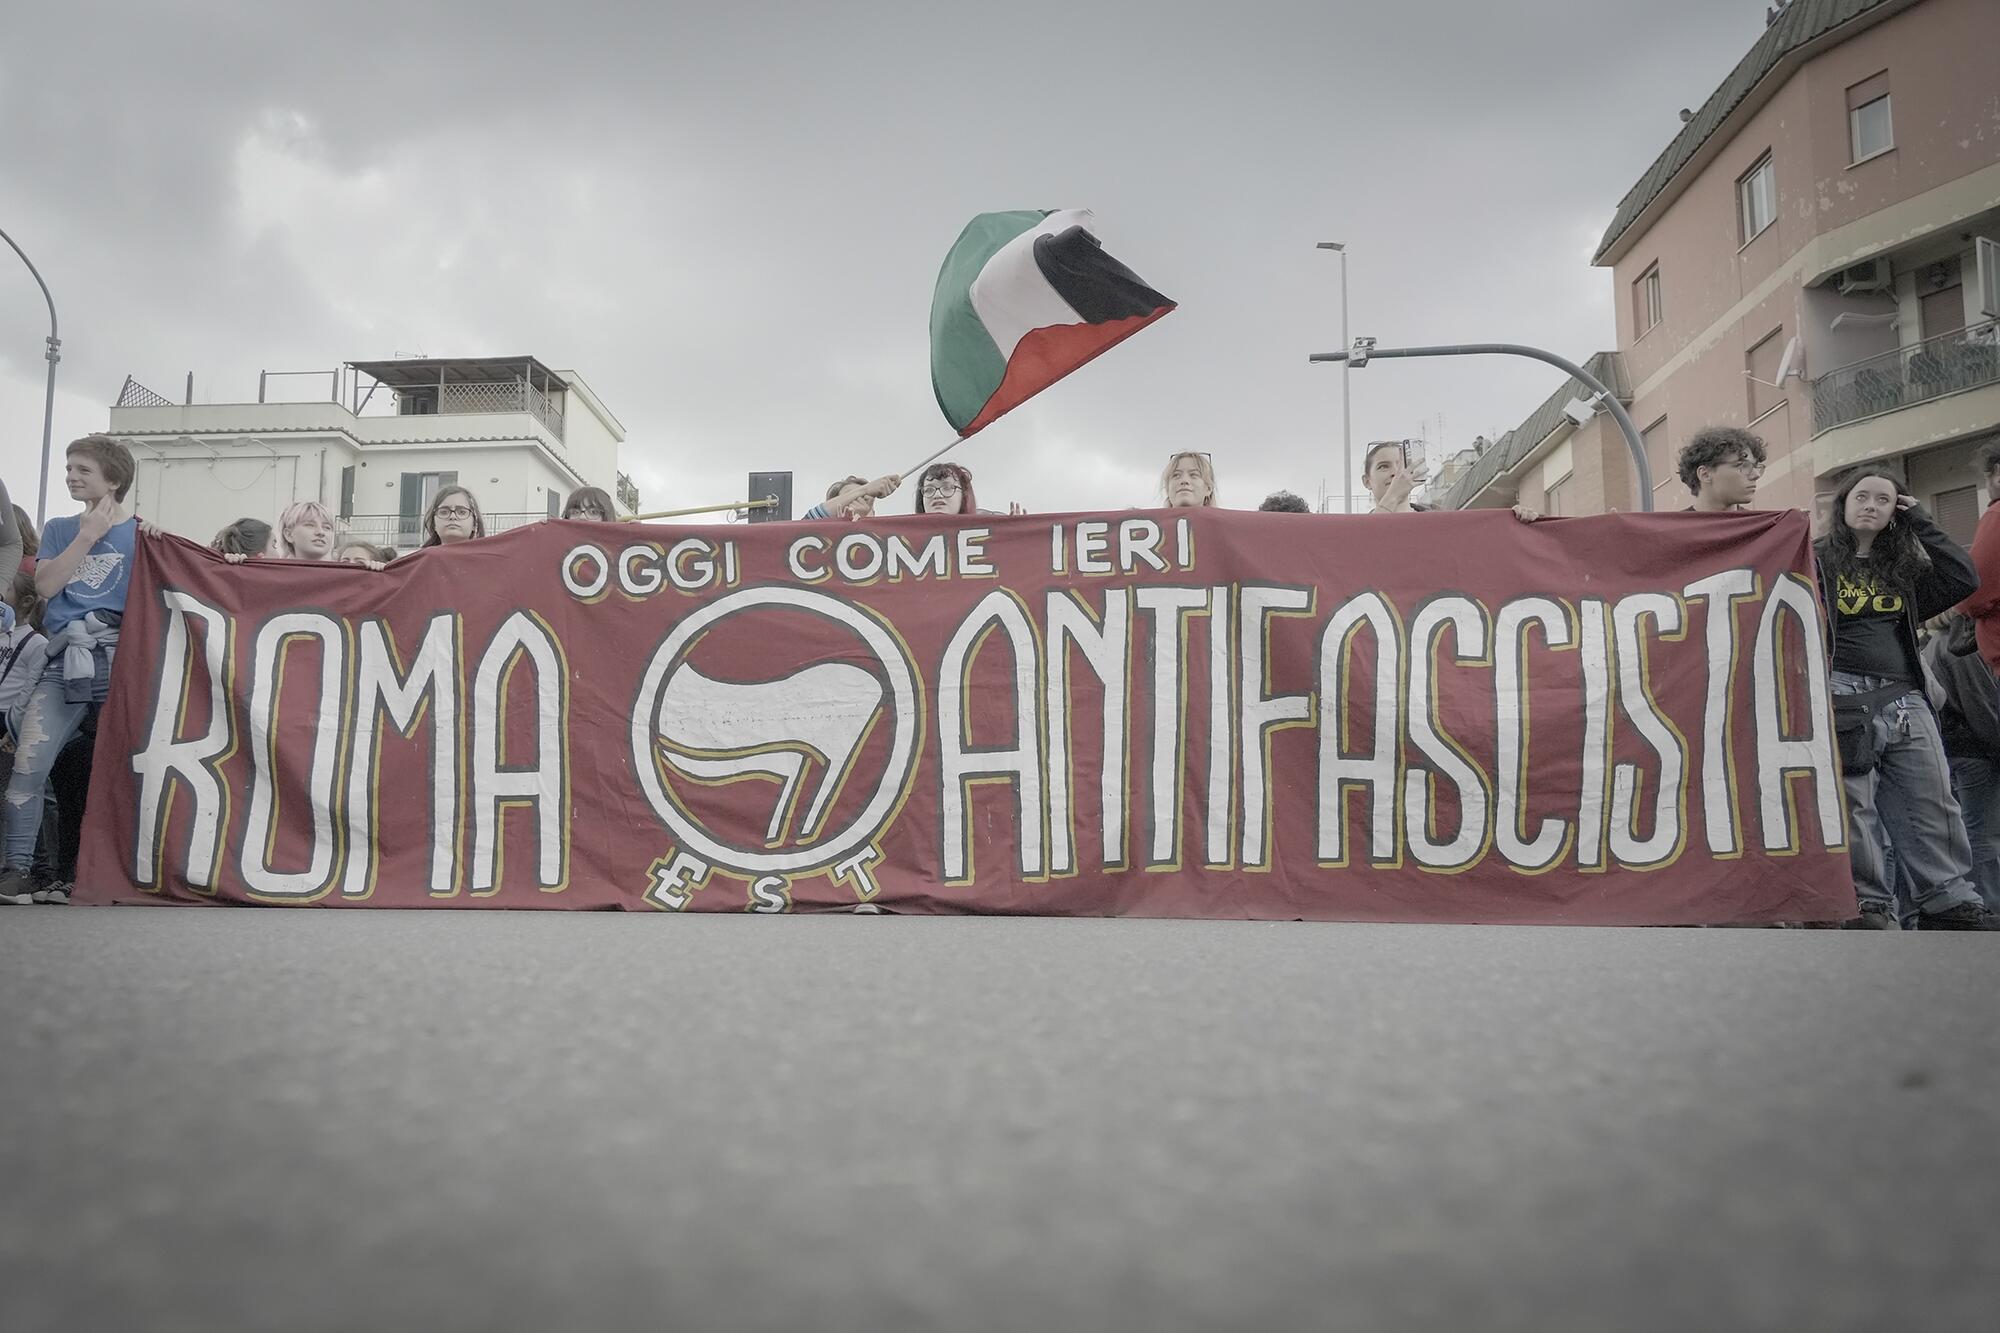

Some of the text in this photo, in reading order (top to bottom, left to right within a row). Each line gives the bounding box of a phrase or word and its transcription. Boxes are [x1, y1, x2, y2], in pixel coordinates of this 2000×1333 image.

[561, 517, 1192, 600] OGGI COME IERI
[132, 568, 1847, 898] ROMA ANTIFASCISTA
